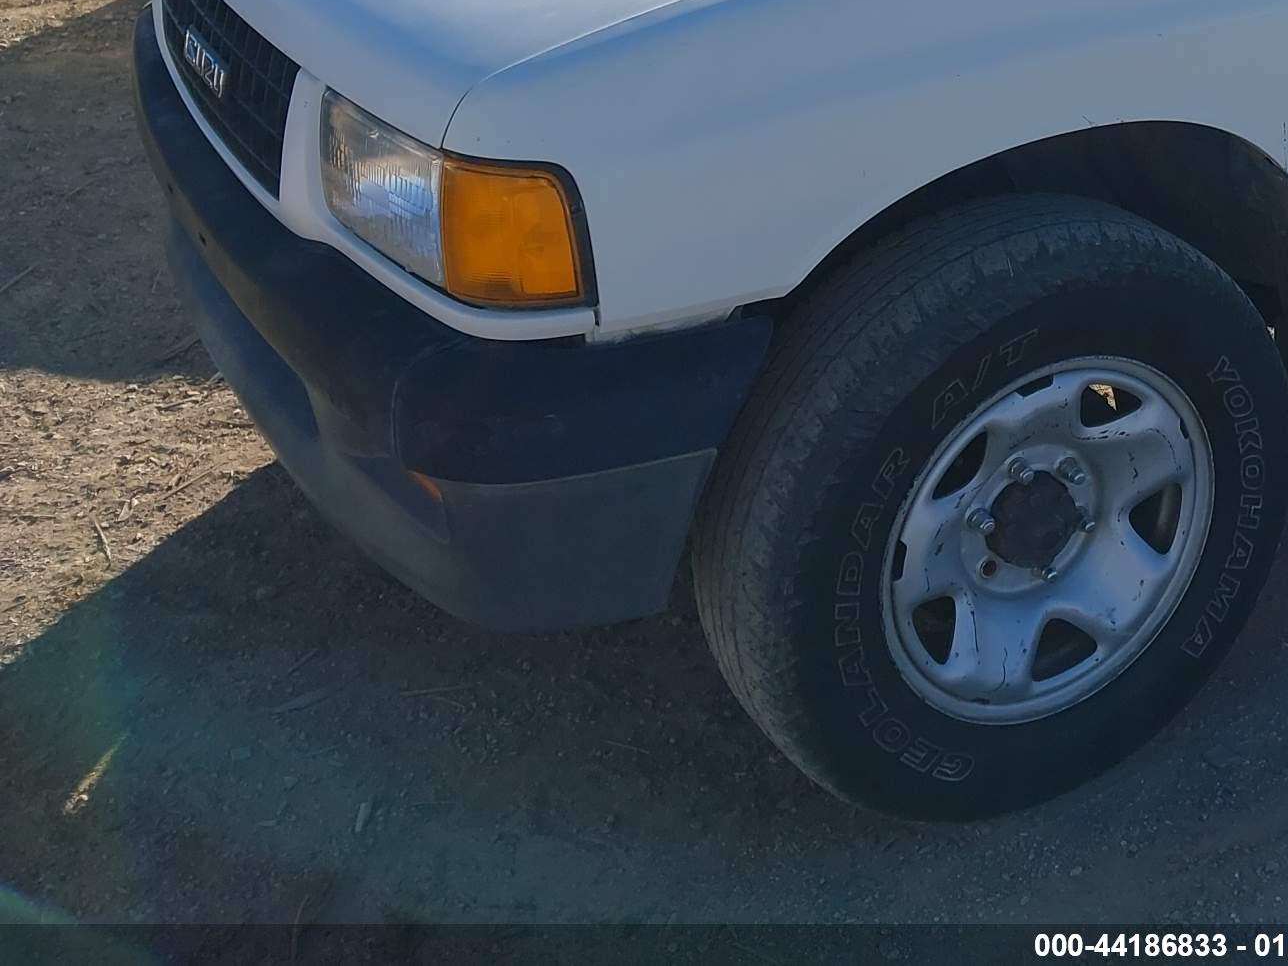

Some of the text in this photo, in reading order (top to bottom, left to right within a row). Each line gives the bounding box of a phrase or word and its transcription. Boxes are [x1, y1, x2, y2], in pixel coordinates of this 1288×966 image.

[834, 328, 1039, 782] GEOLANDAR A/T
[1181, 355, 1266, 659] YOKOHAMA
